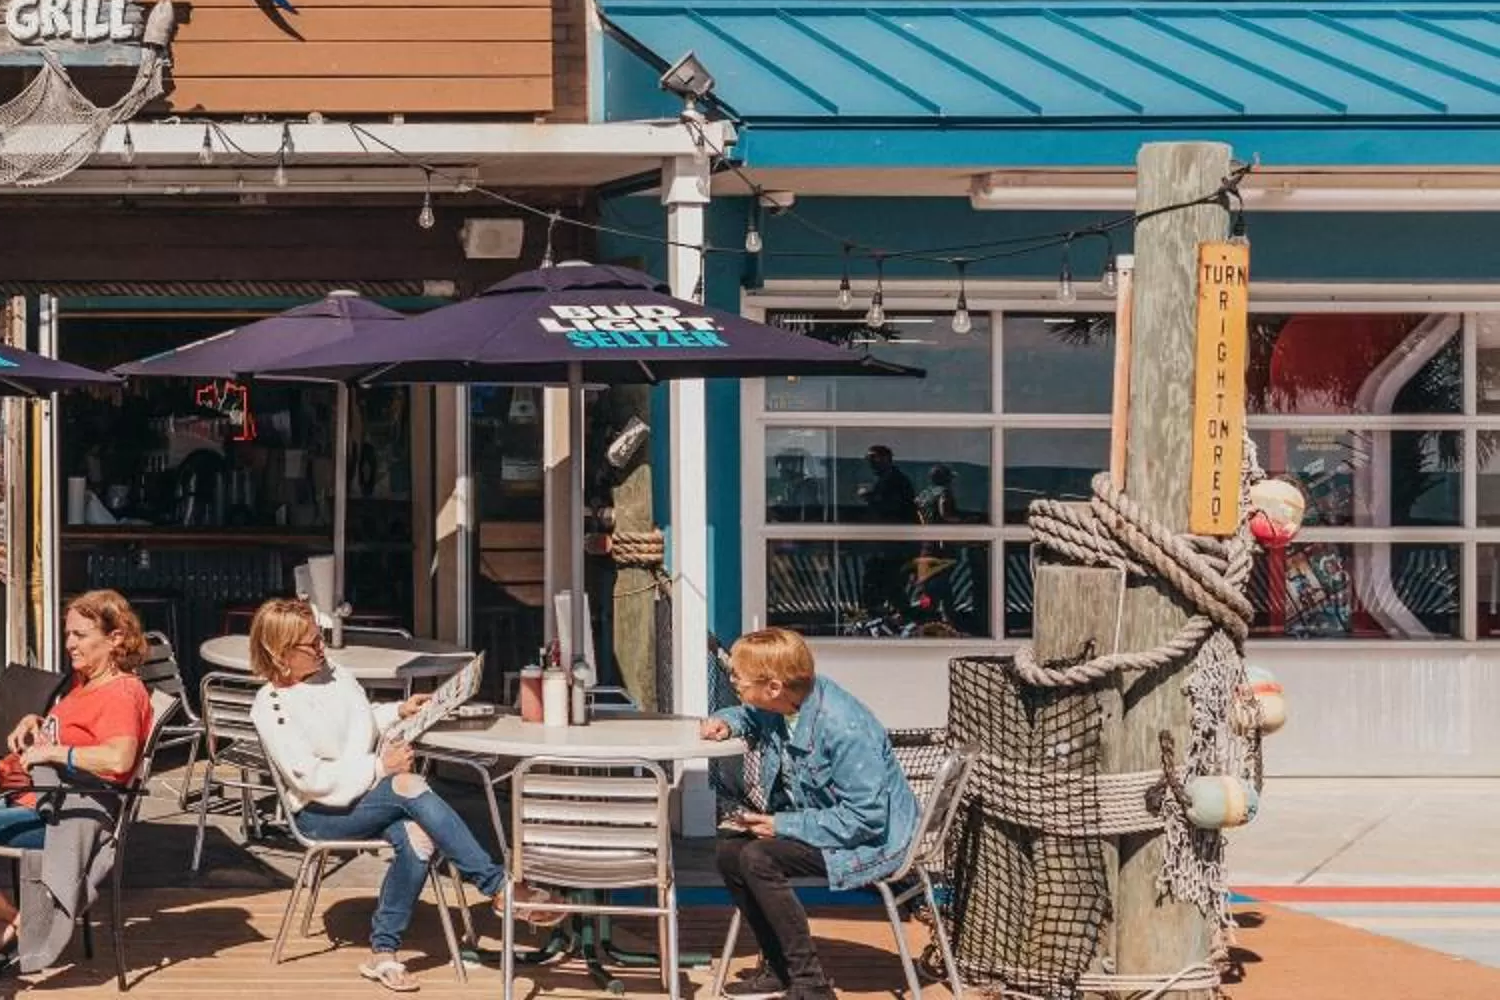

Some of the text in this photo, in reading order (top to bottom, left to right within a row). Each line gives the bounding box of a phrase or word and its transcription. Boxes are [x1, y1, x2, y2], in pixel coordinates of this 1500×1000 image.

[550, 305, 681, 319] BUD
[538, 317, 717, 332] LIGHT
[565, 331, 730, 347] SELTZER
[1204, 264, 1247, 516] TURN RIGHT ON RED
